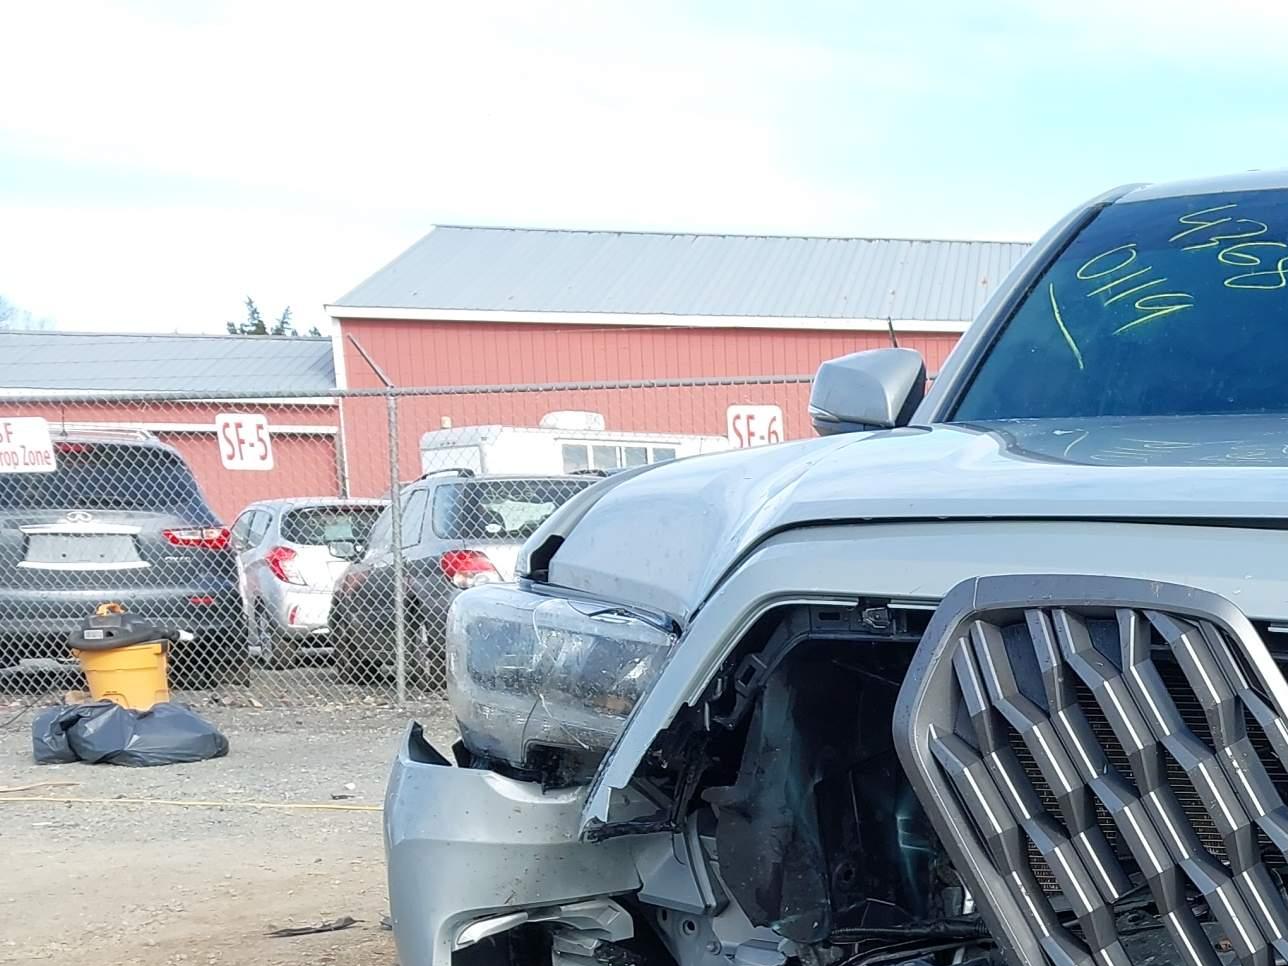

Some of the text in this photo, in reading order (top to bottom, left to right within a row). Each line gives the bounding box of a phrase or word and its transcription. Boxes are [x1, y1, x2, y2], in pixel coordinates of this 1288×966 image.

[1076, 243, 1194, 335] 0119
[222, 421, 268, 461] SF-5
[732, 413, 780, 449] SF-6
[19, 444, 52, 466] Zone
